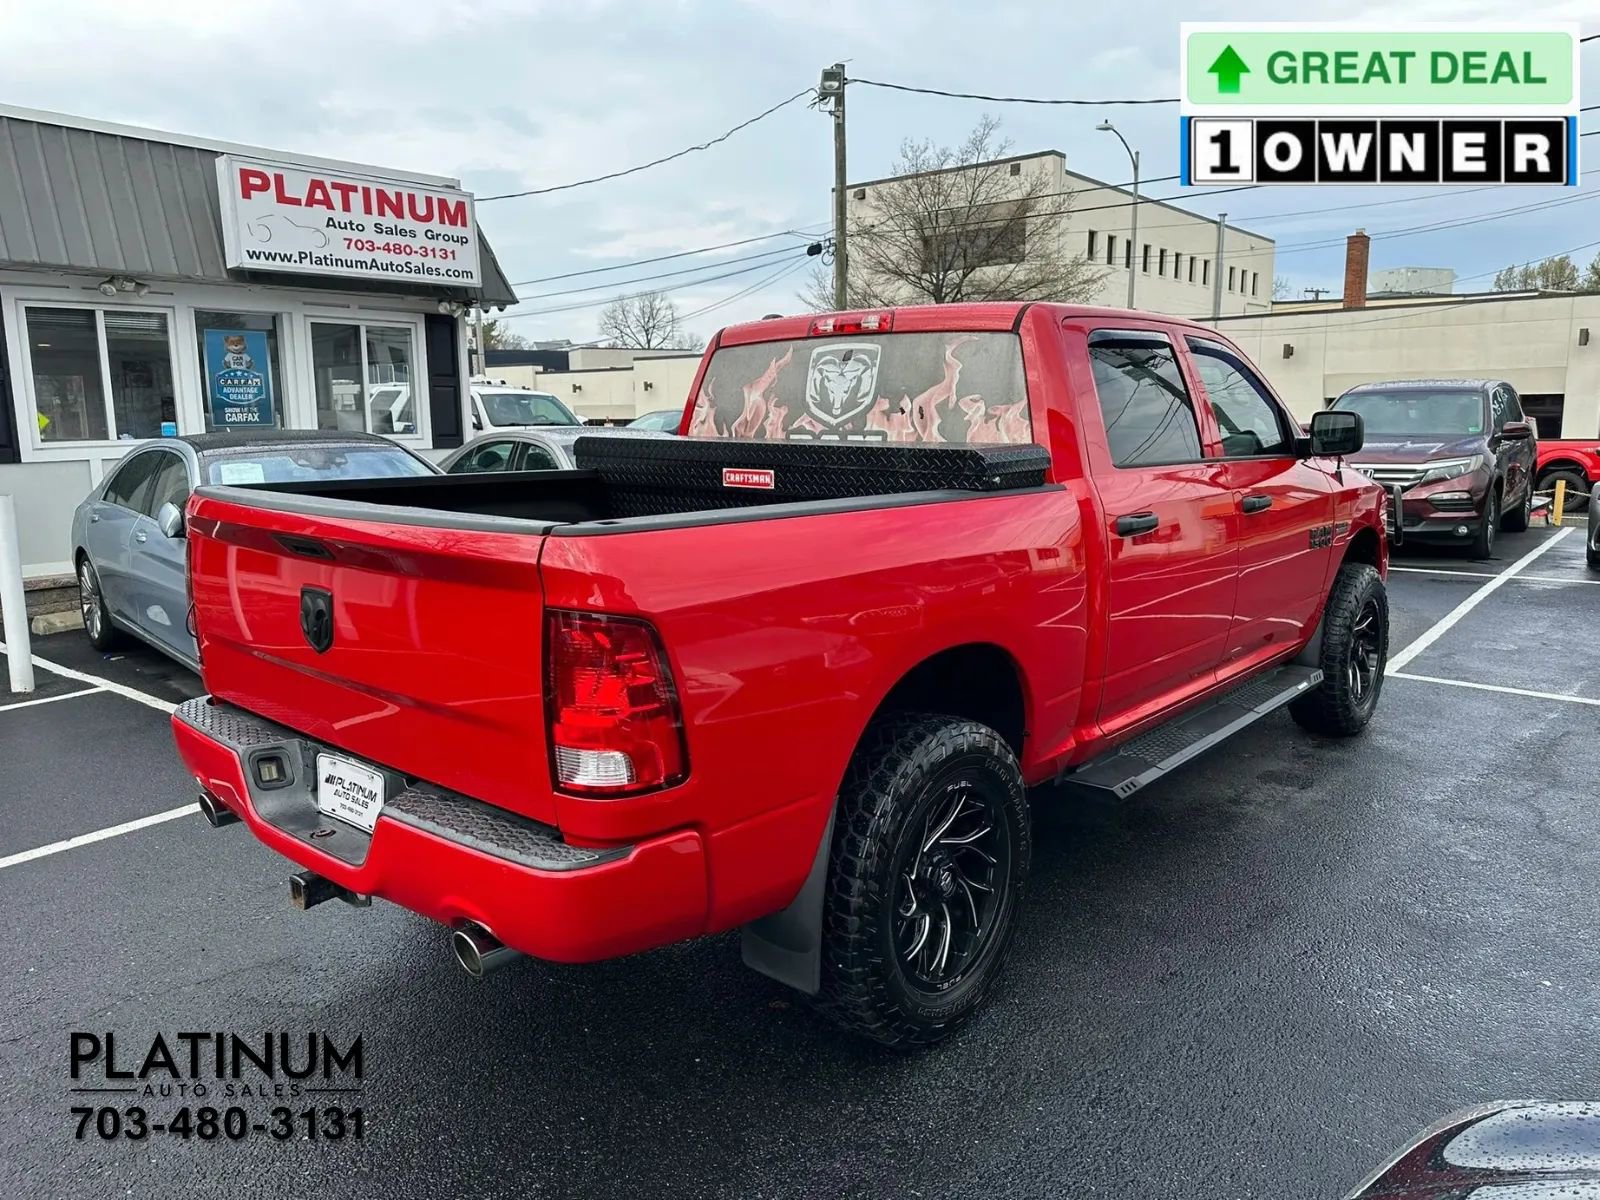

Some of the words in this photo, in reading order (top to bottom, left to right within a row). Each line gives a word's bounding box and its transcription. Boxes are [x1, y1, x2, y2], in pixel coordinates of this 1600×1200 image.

[239, 167, 468, 228] PLATINUM
[325, 217, 366, 232] Auto
[374, 223, 417, 239] Sales
[424, 229, 468, 245] Group
[343, 237, 456, 261] 703-480-3131
[246, 249, 474, 280] www.PlatinumAutoSales.com
[219, 378, 261, 386] CARFAX
[225, 413, 260, 422] CARFAX
[725, 472, 771, 484] CRAFTSMAN
[335, 776, 378, 803] PLATINUM
[947, 780, 972, 792] FUEL
[333, 788, 350, 801] AUTO
[351, 794, 369, 809] SALES
